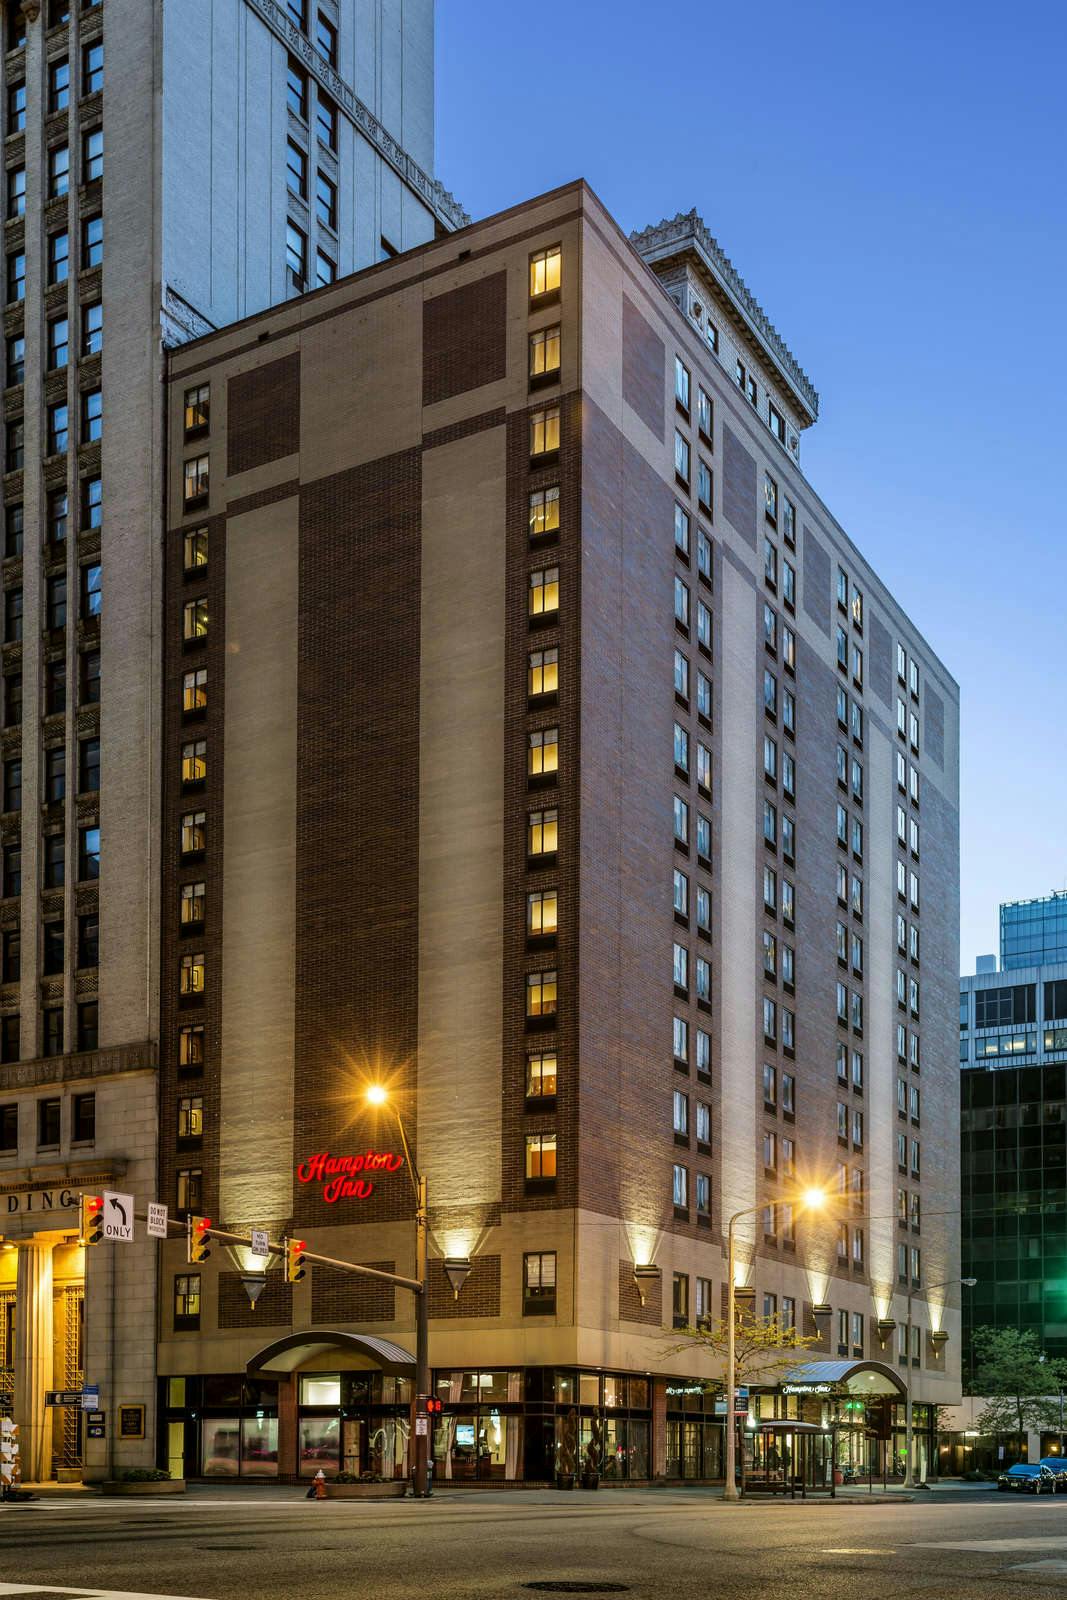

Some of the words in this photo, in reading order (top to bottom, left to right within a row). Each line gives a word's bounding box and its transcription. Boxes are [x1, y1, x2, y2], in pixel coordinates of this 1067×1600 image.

[297, 1150, 402, 1183] Hampton
[323, 1175, 373, 1203] Inn
[7, 1189, 72, 1213] DING
[150, 1215, 165, 1226] BLOCK
[106, 1224, 131, 1238] ONLY
[783, 1384, 815, 1394] Hampton
